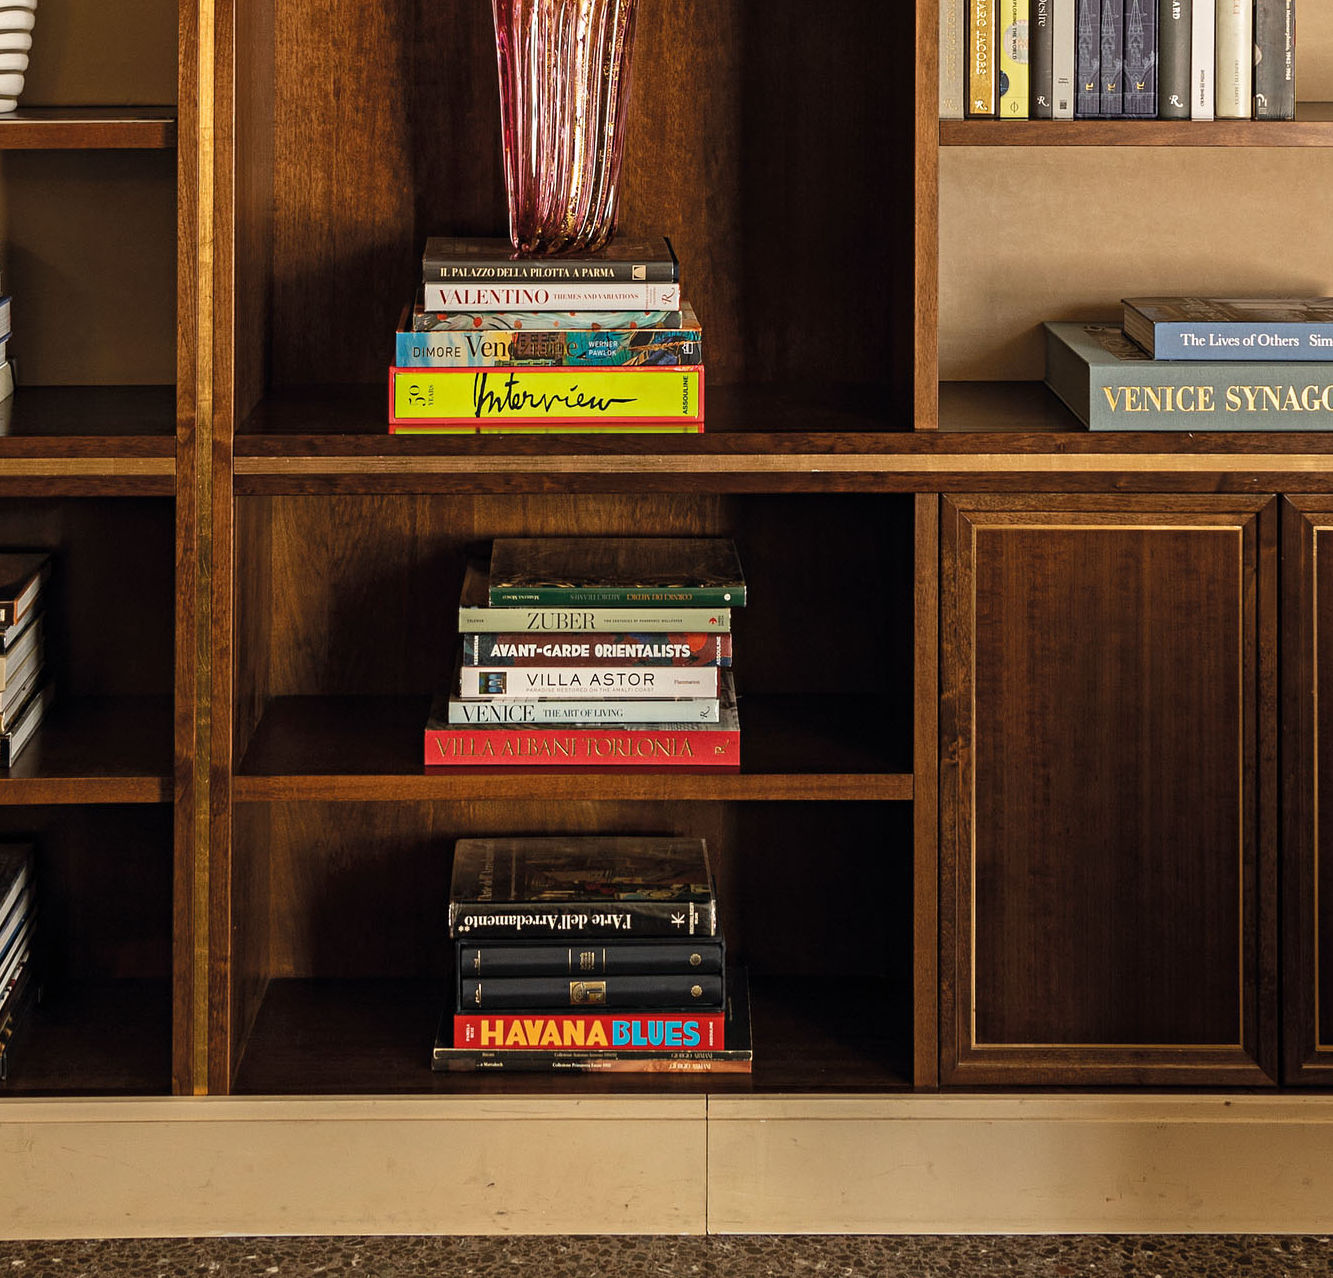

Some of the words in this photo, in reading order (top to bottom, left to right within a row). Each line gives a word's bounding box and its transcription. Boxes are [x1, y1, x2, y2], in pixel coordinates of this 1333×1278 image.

[440, 268, 450, 277] IL
[452, 268, 495, 277] PALAZZO
[497, 268, 527, 278] DELLA
[530, 268, 569, 278] PILOTTA
[573, 268, 580, 277] A
[582, 268, 614, 277] PARMA
[440, 289, 549, 305] VALENTINO
[413, 346, 460, 357] DIMORE
[465, 335, 577, 357] Veneziane
[1180, 334, 1206, 347] The
[1209, 334, 1239, 347] Lives
[1242, 334, 1255, 347] of
[1256, 334, 1299, 347] Others
[474, 373, 638, 417] Interview
[1102, 386, 1215, 412] VENICE
[527, 612, 595, 630] ZUBER
[491, 644, 589, 657] AVANT-GARDE
[595, 644, 690, 657] ORIENTALISTS
[527, 674, 580, 686] VILLA
[590, 673, 654, 686] ASTOR
[463, 705, 535, 722] VENICE
[436, 738, 495, 756] VILLA
[501, 738, 577, 756] ALBANI
[582, 738, 693, 757] TORLONIA
[481, 1020, 608, 1046] HAVANA
[612, 1021, 700, 1046] BLUES
